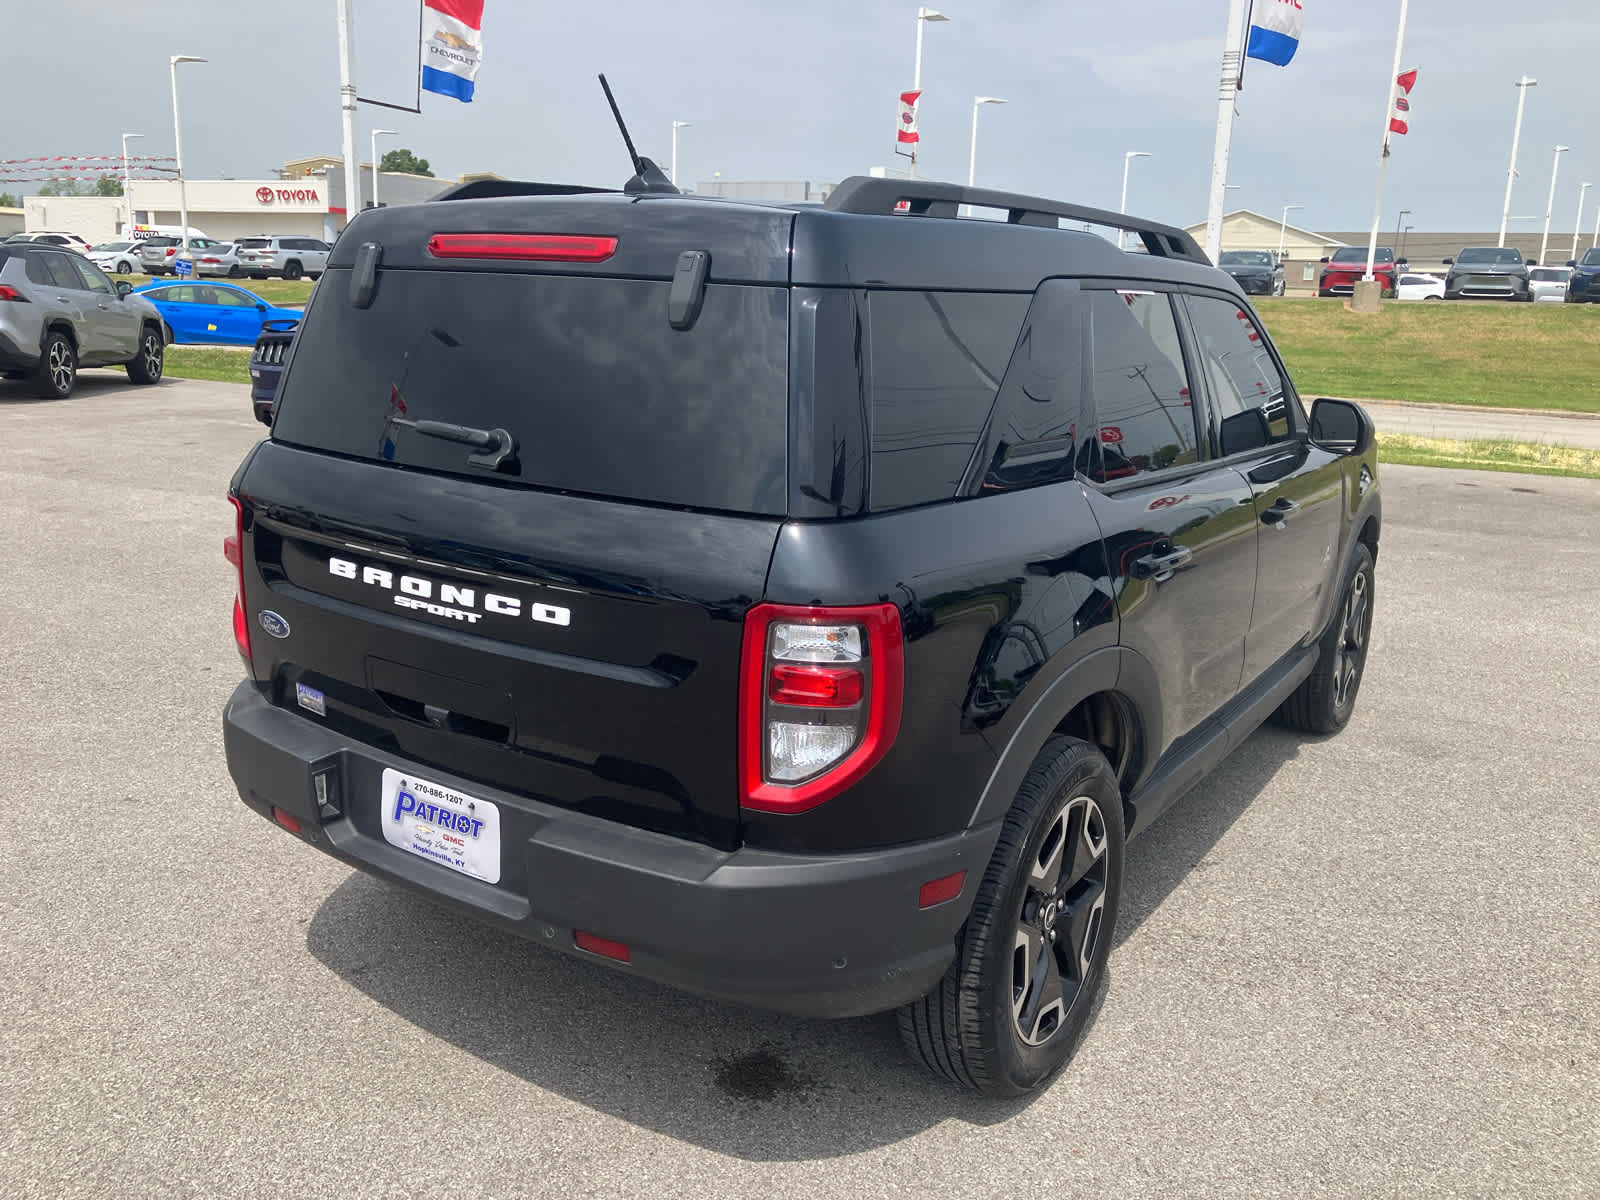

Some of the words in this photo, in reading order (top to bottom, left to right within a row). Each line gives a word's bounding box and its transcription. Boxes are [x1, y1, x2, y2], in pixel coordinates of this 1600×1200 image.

[430, 46, 475, 66] CHEVROLET
[275, 189, 319, 201] TOYOTA
[328, 556, 572, 627] BRONCO
[393, 595, 482, 624] SPORT
[262, 615, 281, 634] Ford
[414, 783, 463, 805] 270-886-1207
[394, 791, 483, 837] PATRIOT
[442, 833, 465, 847] GMC
[413, 843, 454, 864] Hopkinsville,
[455, 858, 465, 869] KY
